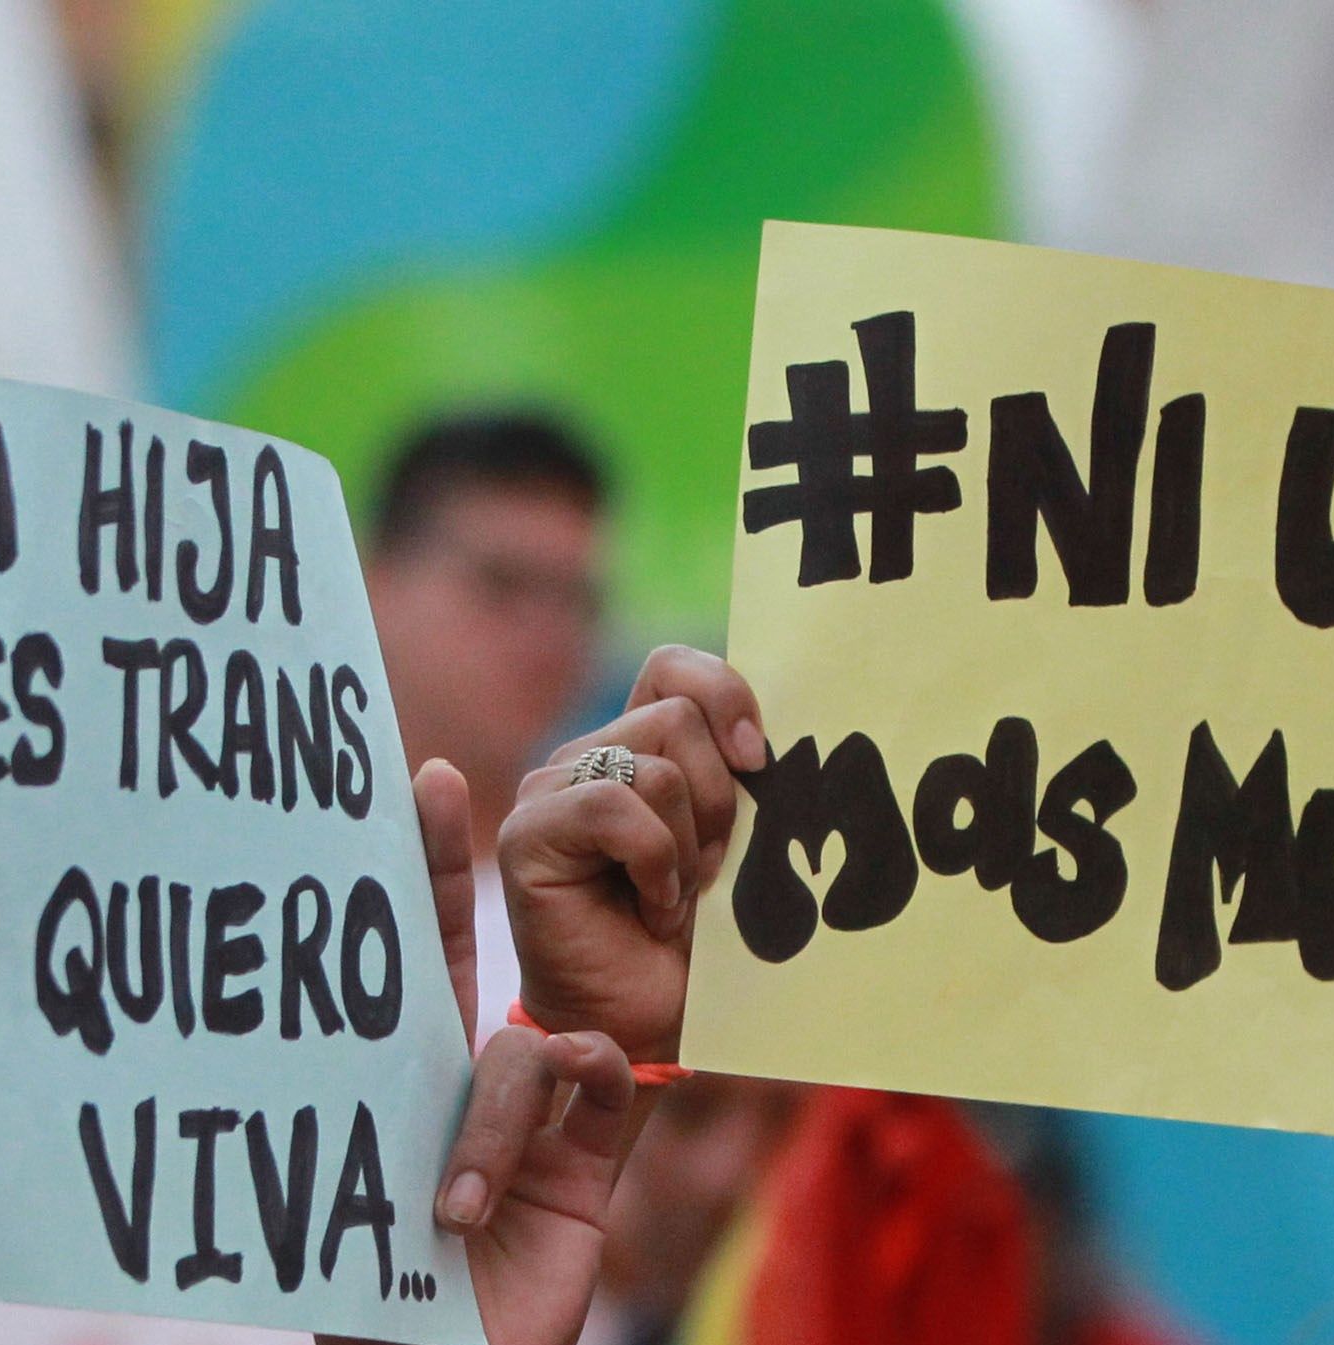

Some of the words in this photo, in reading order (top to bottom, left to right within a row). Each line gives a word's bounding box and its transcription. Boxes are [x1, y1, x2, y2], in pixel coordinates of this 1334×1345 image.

[77, 420, 302, 626] HIJA
[101, 636, 373, 821] TRANS
[34, 866, 403, 1056] QUIERO
